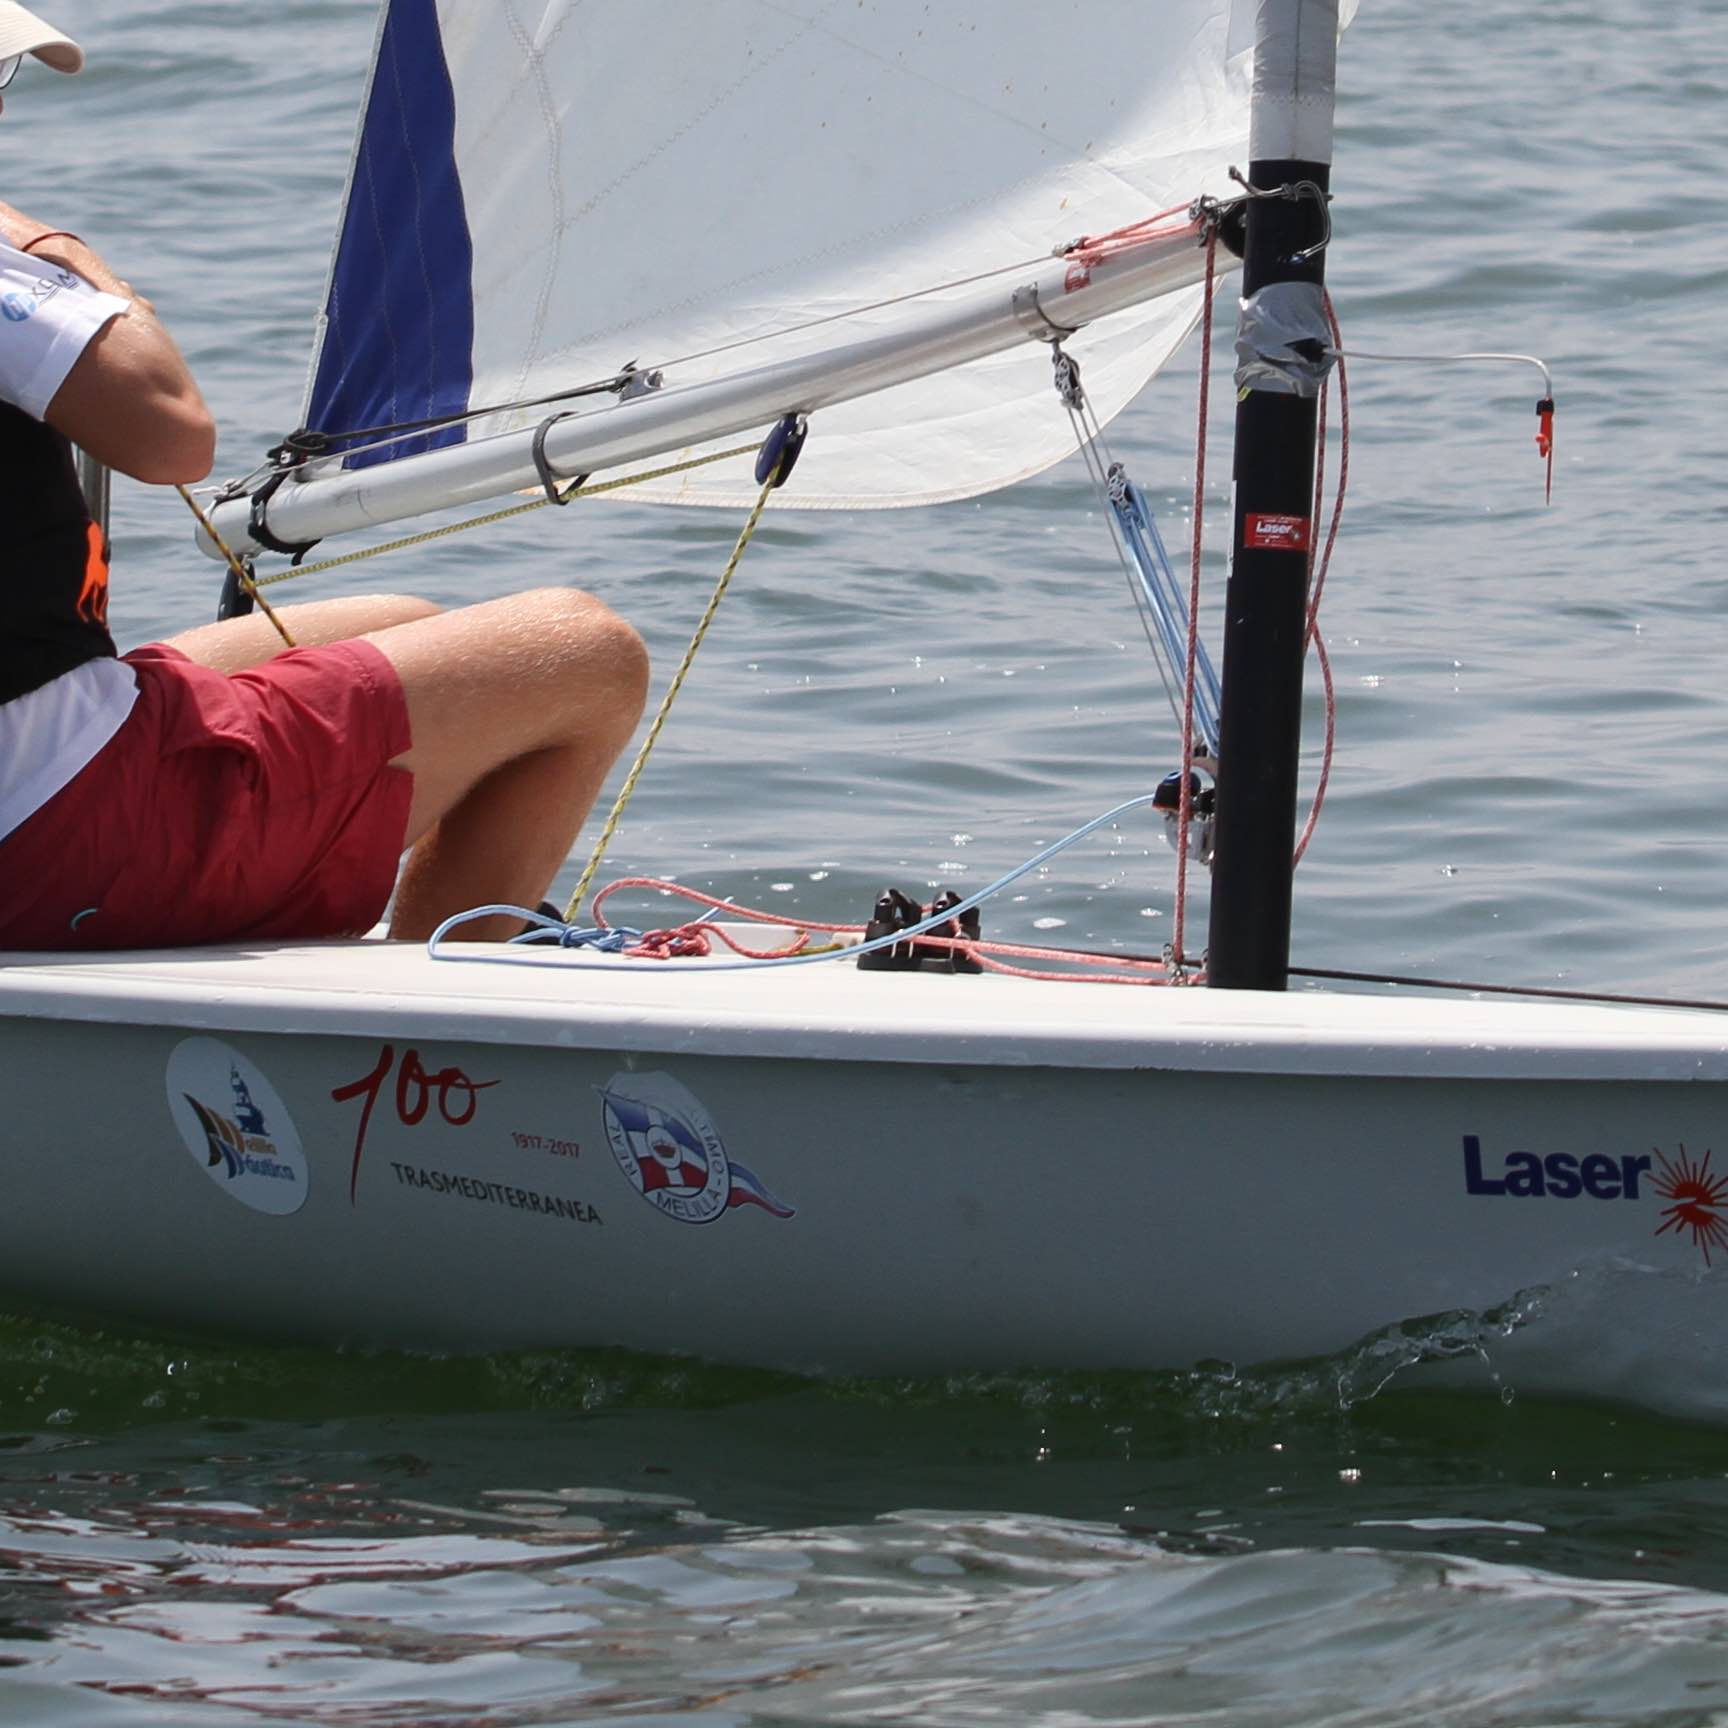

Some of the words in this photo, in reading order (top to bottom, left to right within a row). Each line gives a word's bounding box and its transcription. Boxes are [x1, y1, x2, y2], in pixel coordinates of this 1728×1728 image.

[1256, 521, 1293, 534] Laser
[332, 1044, 501, 1208] 100
[511, 1131, 581, 1159] 1917-2017
[391, 1162, 603, 1226] TRASMEDITERRANEA
[607, 1121, 640, 1177] REAL
[654, 1188, 722, 1219] MELILLA
[1462, 1134, 1651, 1199] Laser
